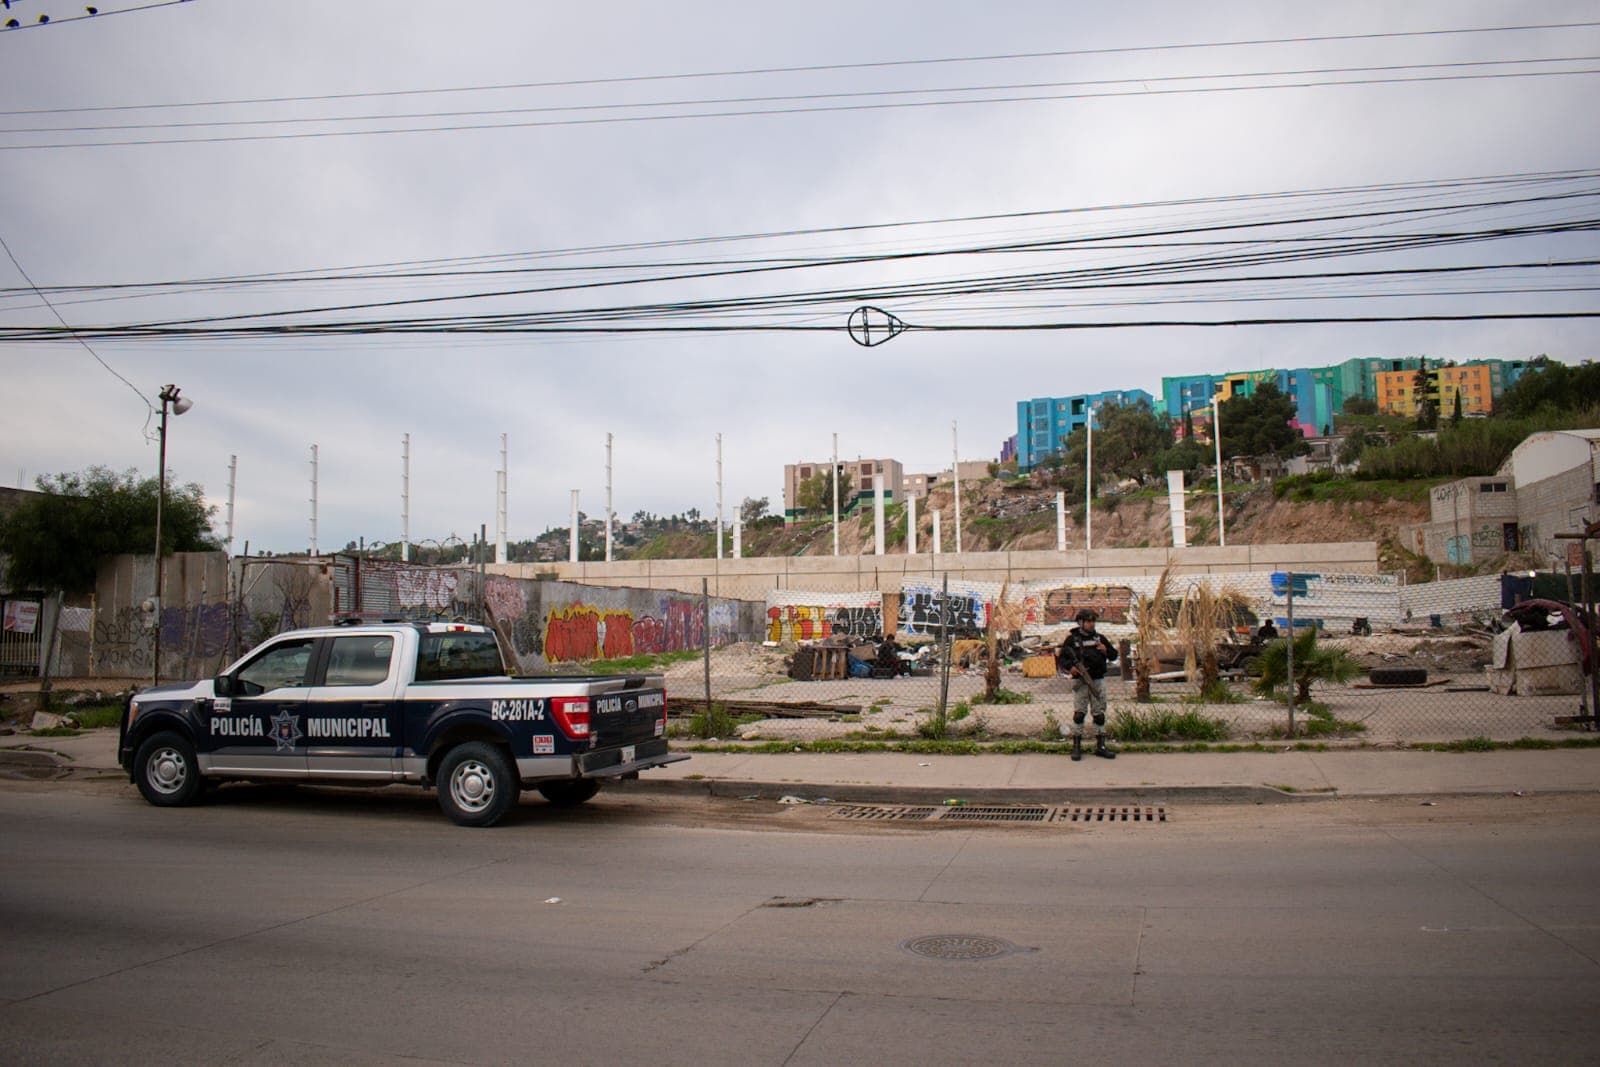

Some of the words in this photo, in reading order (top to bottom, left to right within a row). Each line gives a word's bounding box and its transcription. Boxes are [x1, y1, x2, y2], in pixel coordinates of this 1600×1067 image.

[491, 699, 545, 721] BC-281A-2
[210, 714, 264, 737] POLICÍA
[307, 717, 391, 738] MUNICIPAL
